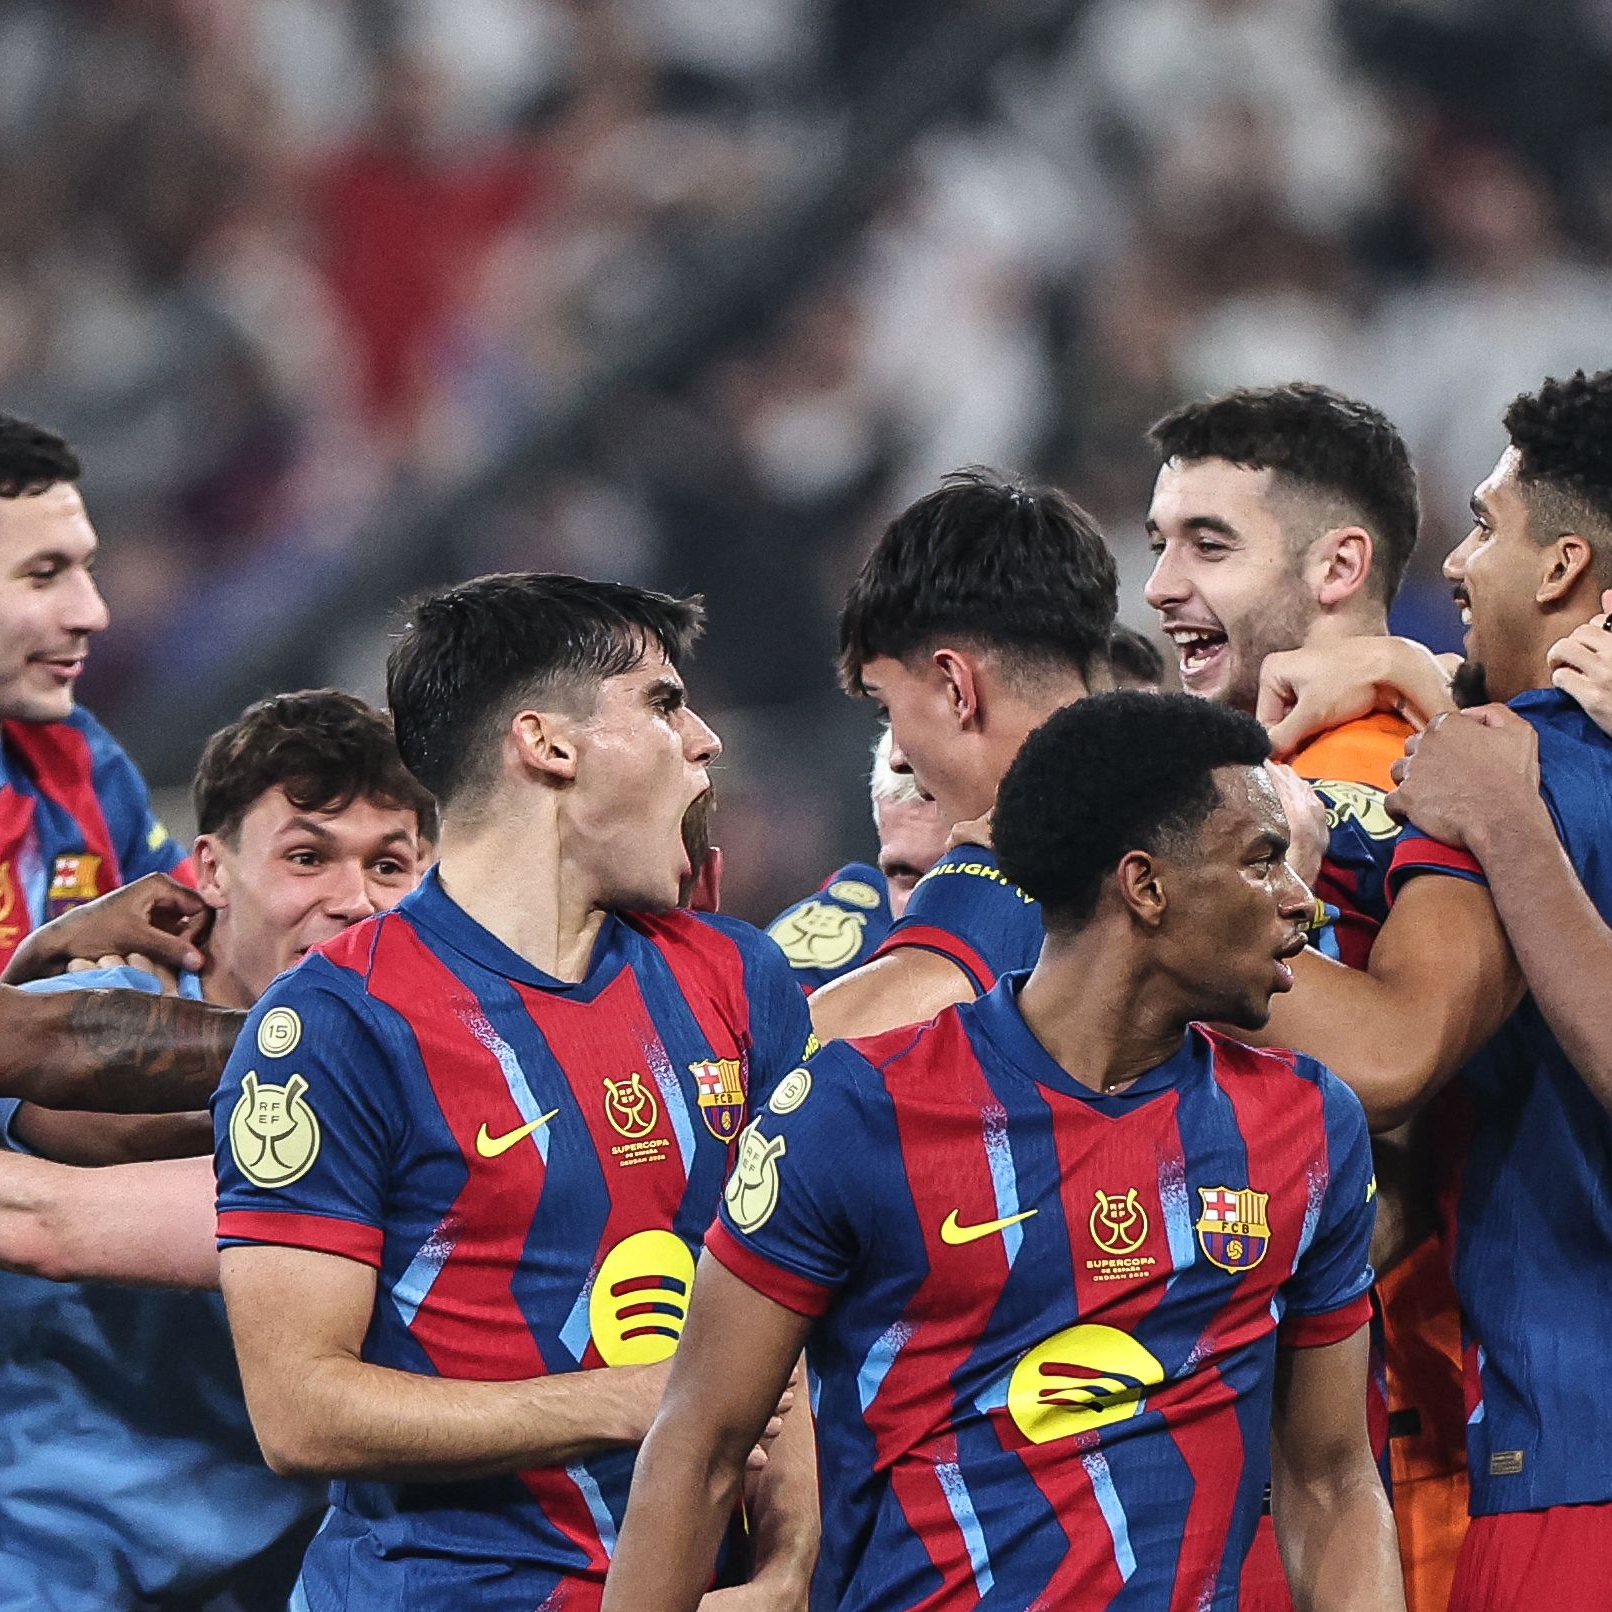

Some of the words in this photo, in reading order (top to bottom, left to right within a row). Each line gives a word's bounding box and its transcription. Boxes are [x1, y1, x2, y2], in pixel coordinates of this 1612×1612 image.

[268, 1025, 288, 1039] 15
[714, 1094, 733, 1104] FCB
[259, 1102, 280, 1112] RF
[259, 1115, 280, 1124] EF
[611, 1139, 670, 1155] SUPERCOPA
[1221, 1222, 1250, 1234] FCB
[1086, 1257, 1156, 1269] SUPERCOPA
